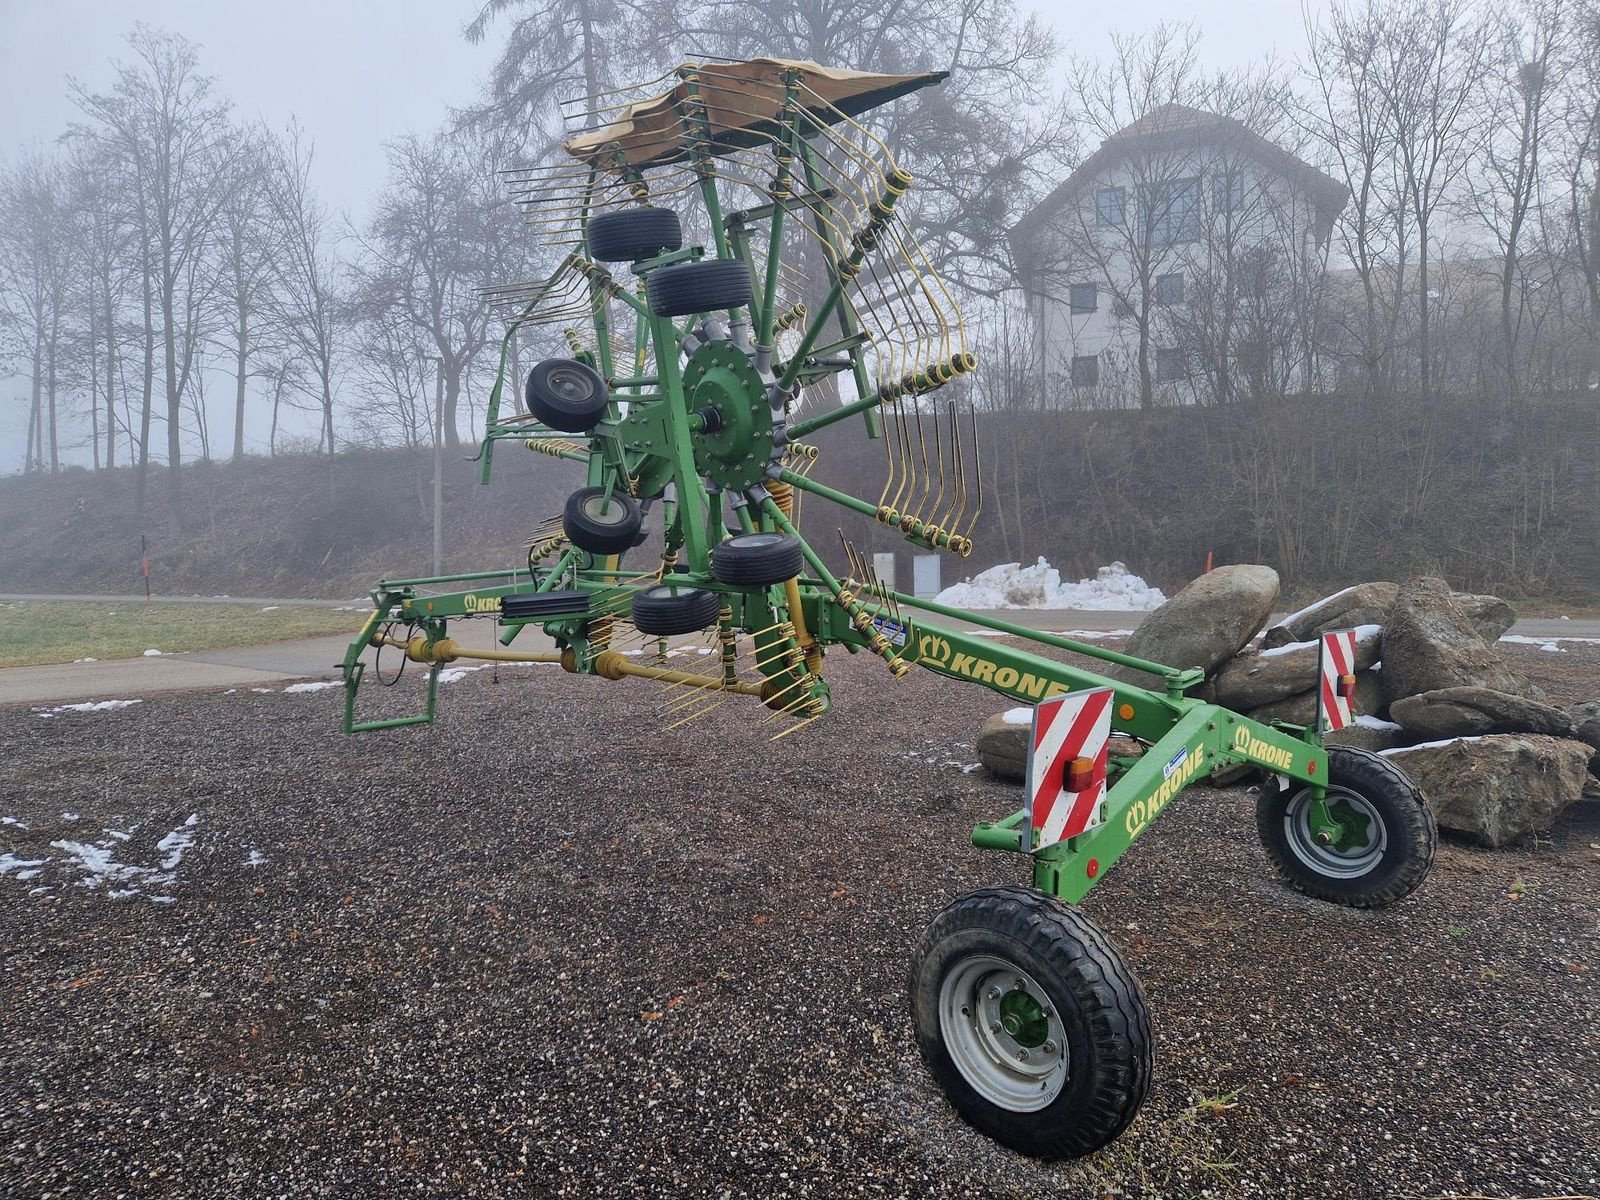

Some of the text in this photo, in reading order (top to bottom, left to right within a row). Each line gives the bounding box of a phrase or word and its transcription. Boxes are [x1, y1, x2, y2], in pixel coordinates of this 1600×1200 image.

[477, 596, 502, 611] KRO
[1249, 738, 1293, 769] KRONE
[1147, 742, 1205, 820] KRONE
